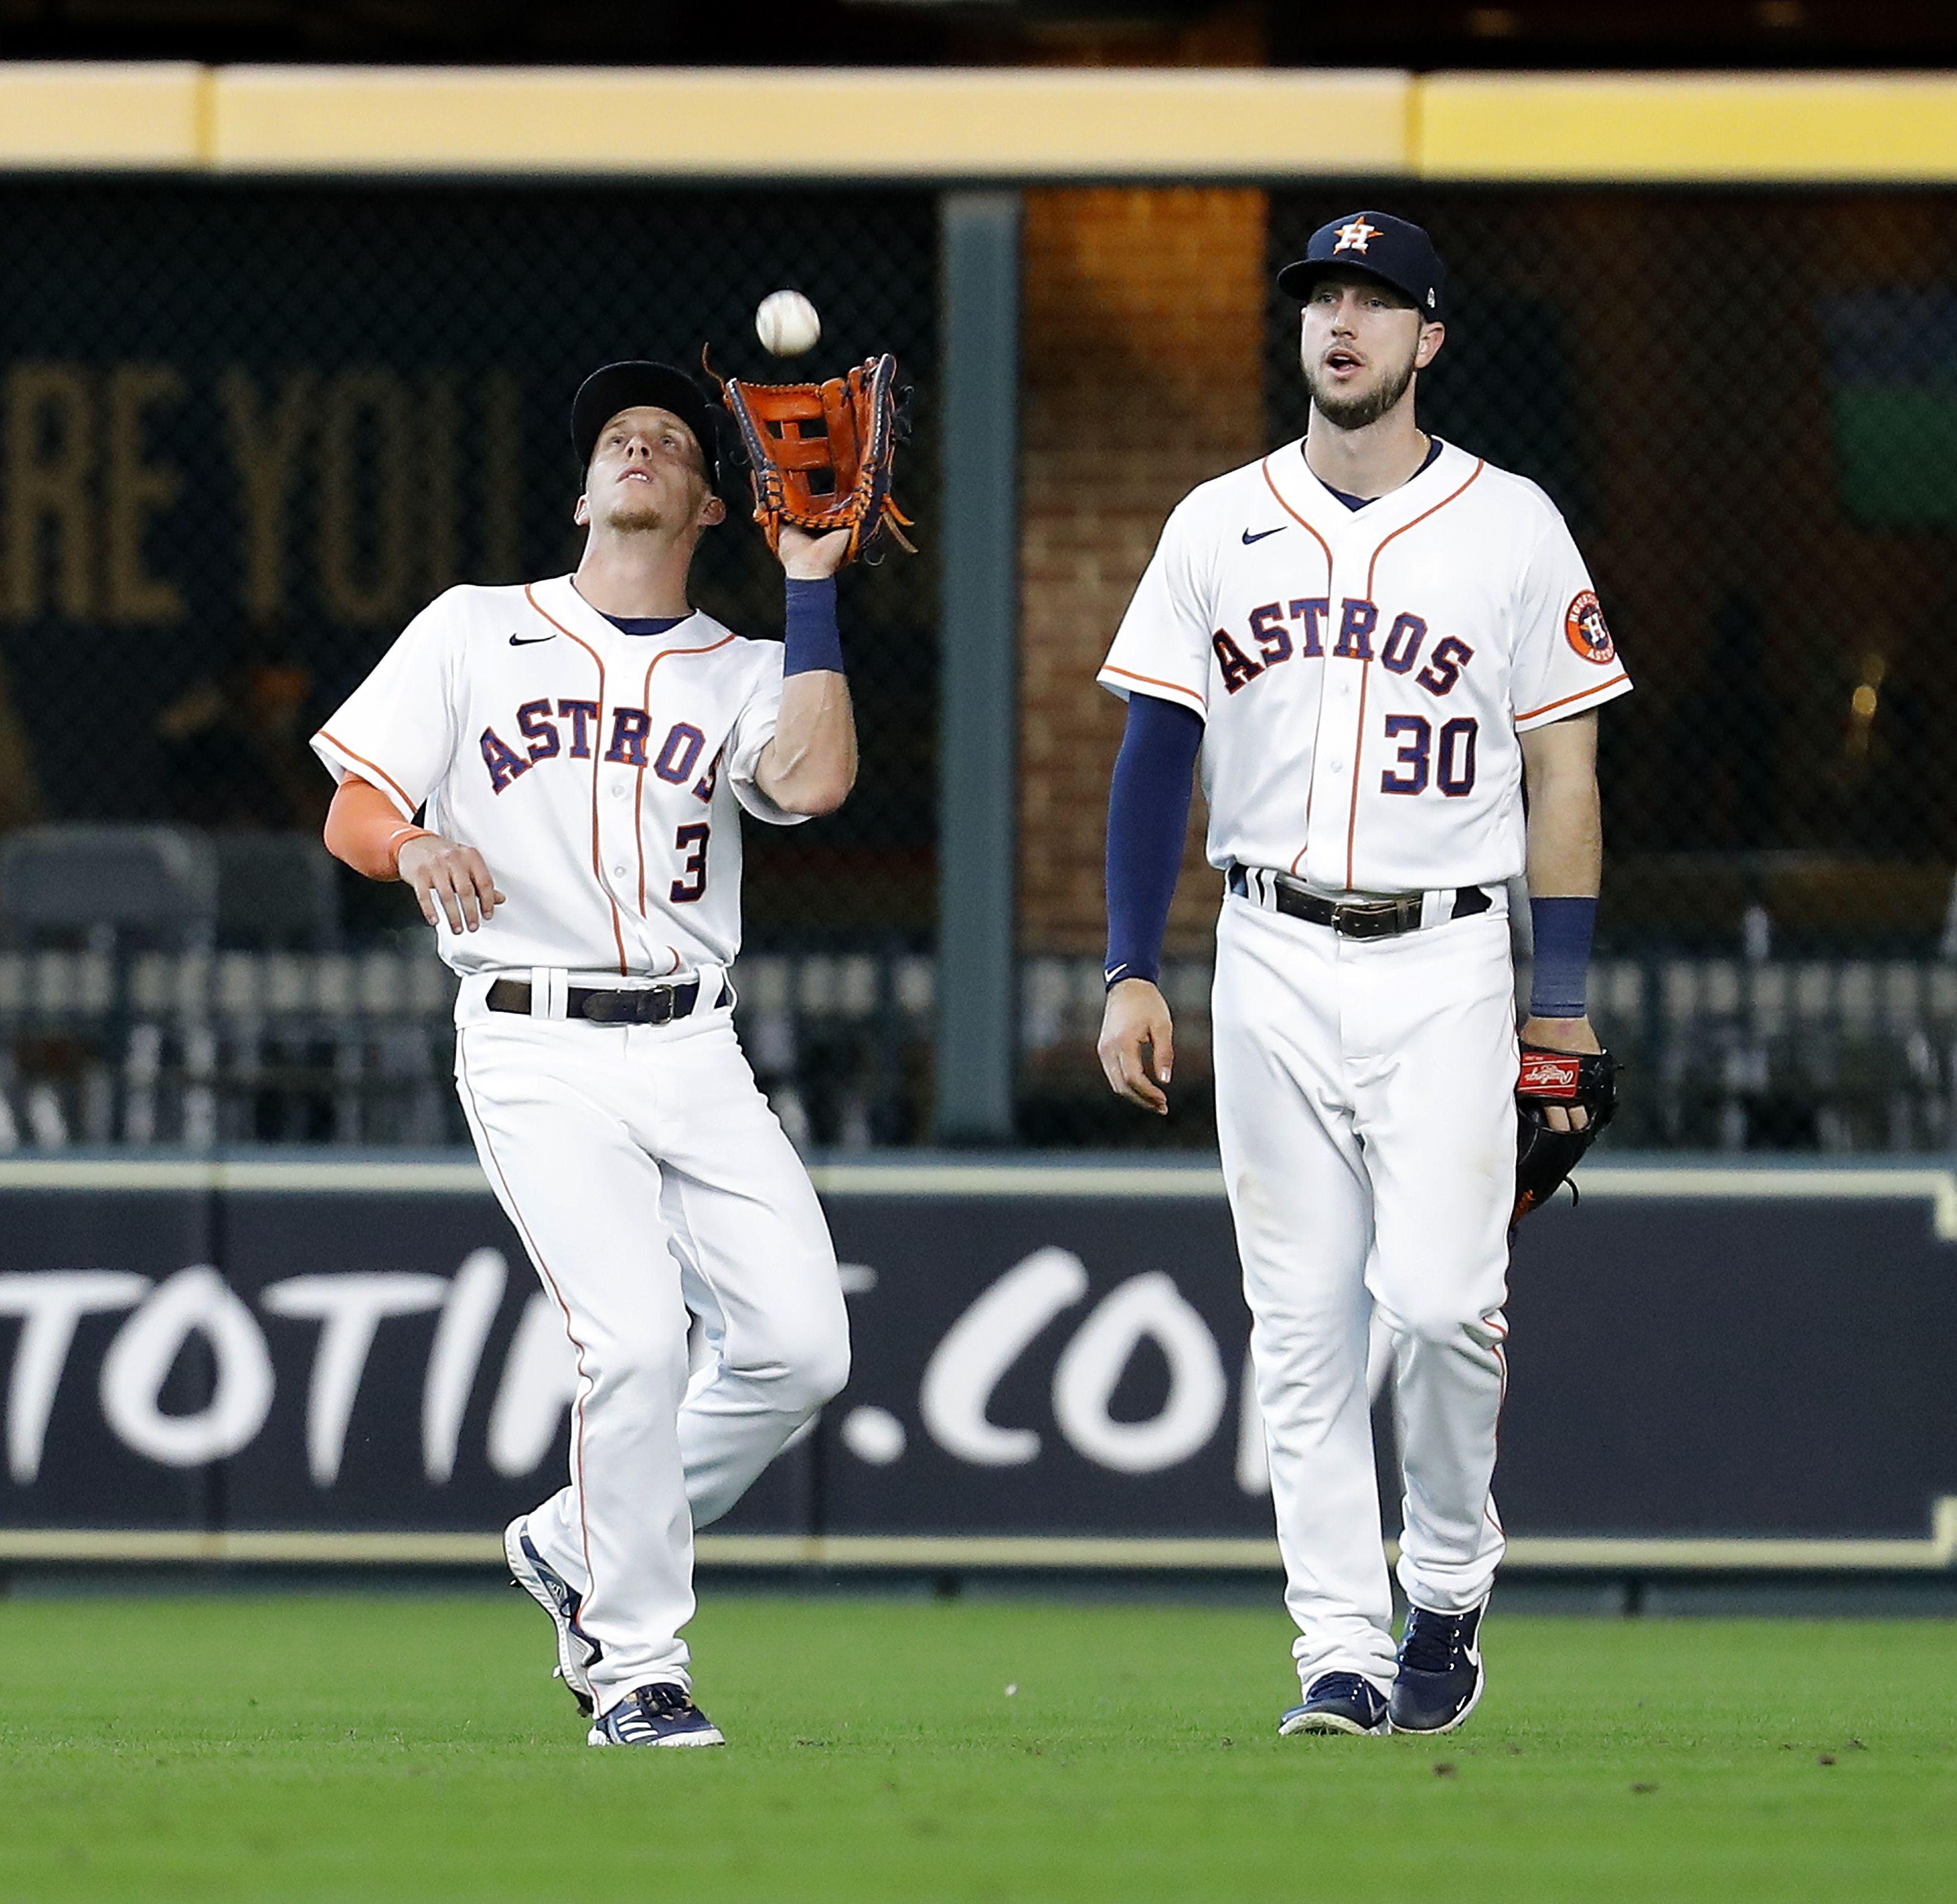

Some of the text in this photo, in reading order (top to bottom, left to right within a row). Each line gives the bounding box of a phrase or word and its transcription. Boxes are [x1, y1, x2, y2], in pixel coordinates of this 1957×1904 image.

[1335, 224, 1375, 249] H
[1212, 598, 1474, 697] ASTROS
[1381, 714, 1478, 798] 30
[669, 822, 711, 903] 3
